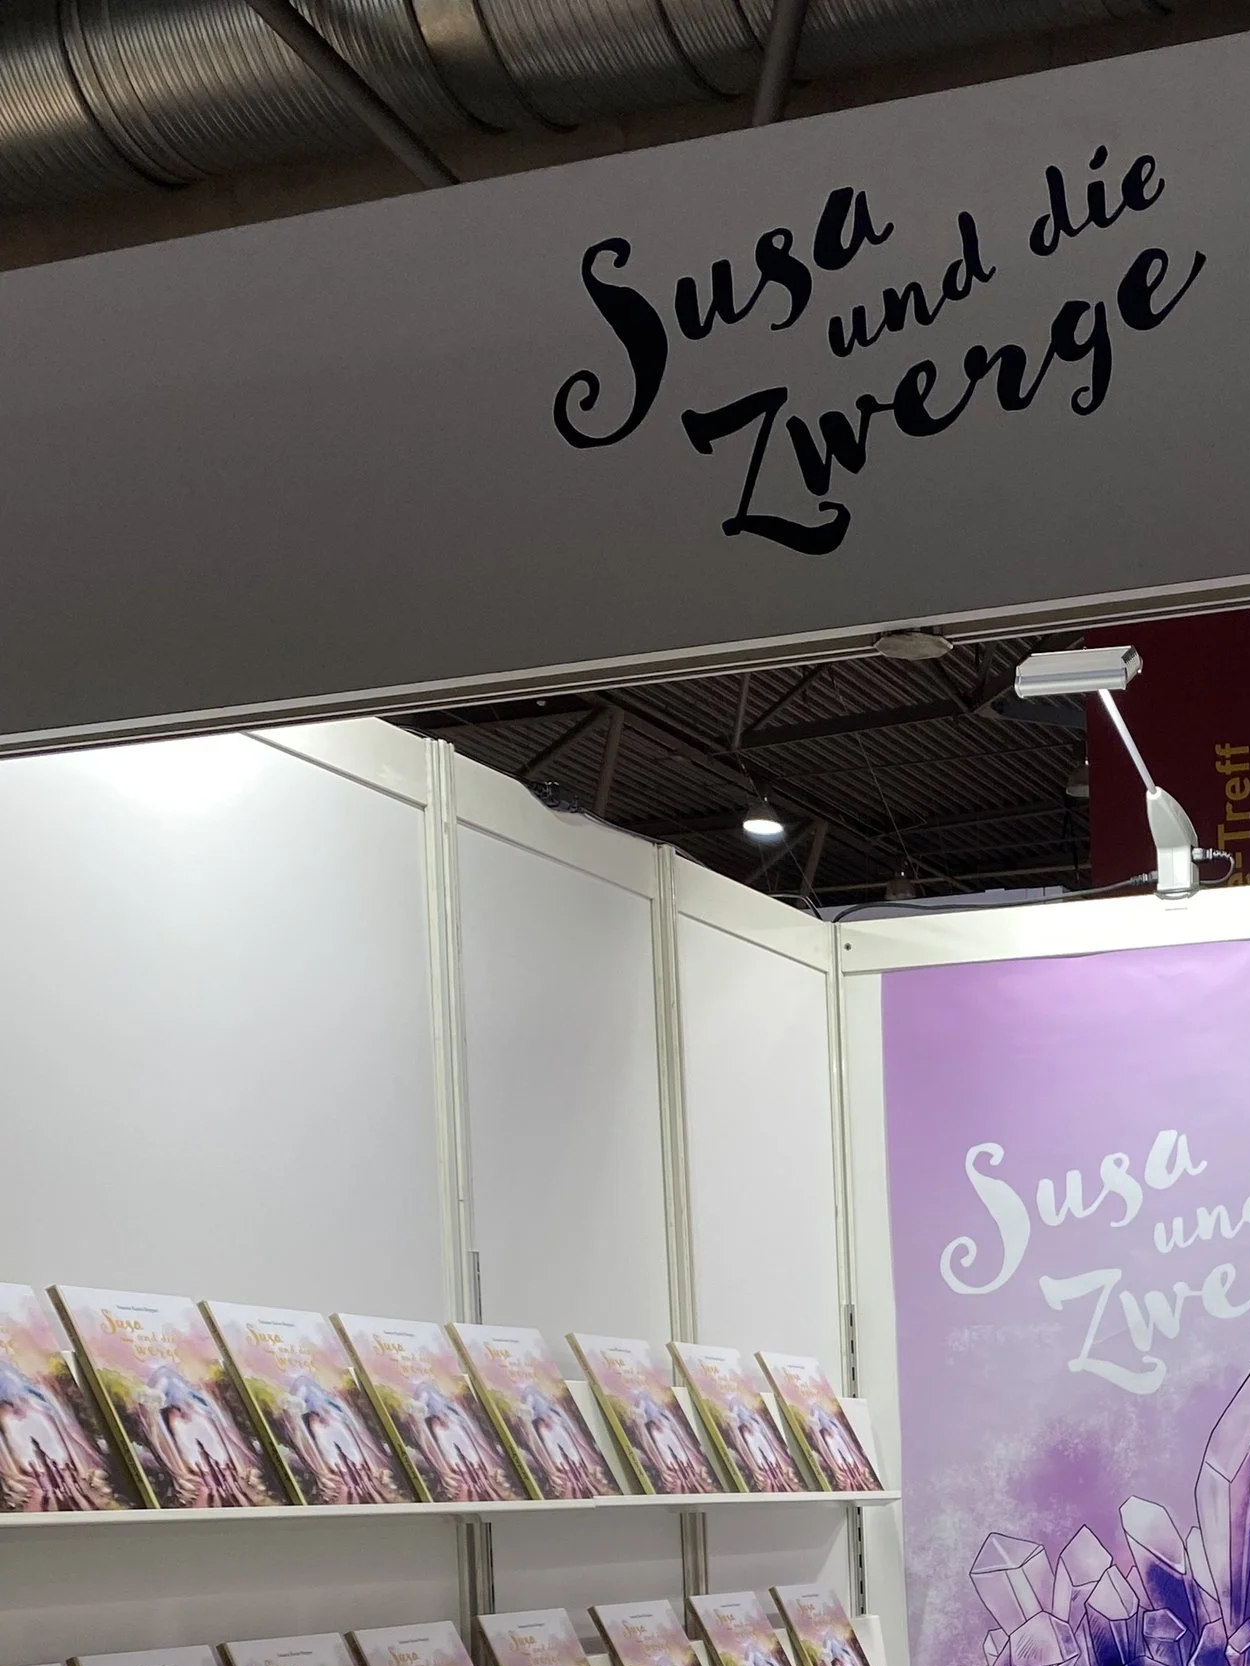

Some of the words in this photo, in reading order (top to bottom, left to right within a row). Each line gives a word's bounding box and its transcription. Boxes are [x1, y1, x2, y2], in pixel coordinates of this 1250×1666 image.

[553, 187, 895, 449] Susa
[828, 212, 997, 358] und
[1029, 145, 1165, 257] die
[680, 248, 1207, 556] Zwerge
[940, 1129, 1207, 1294] Susa
